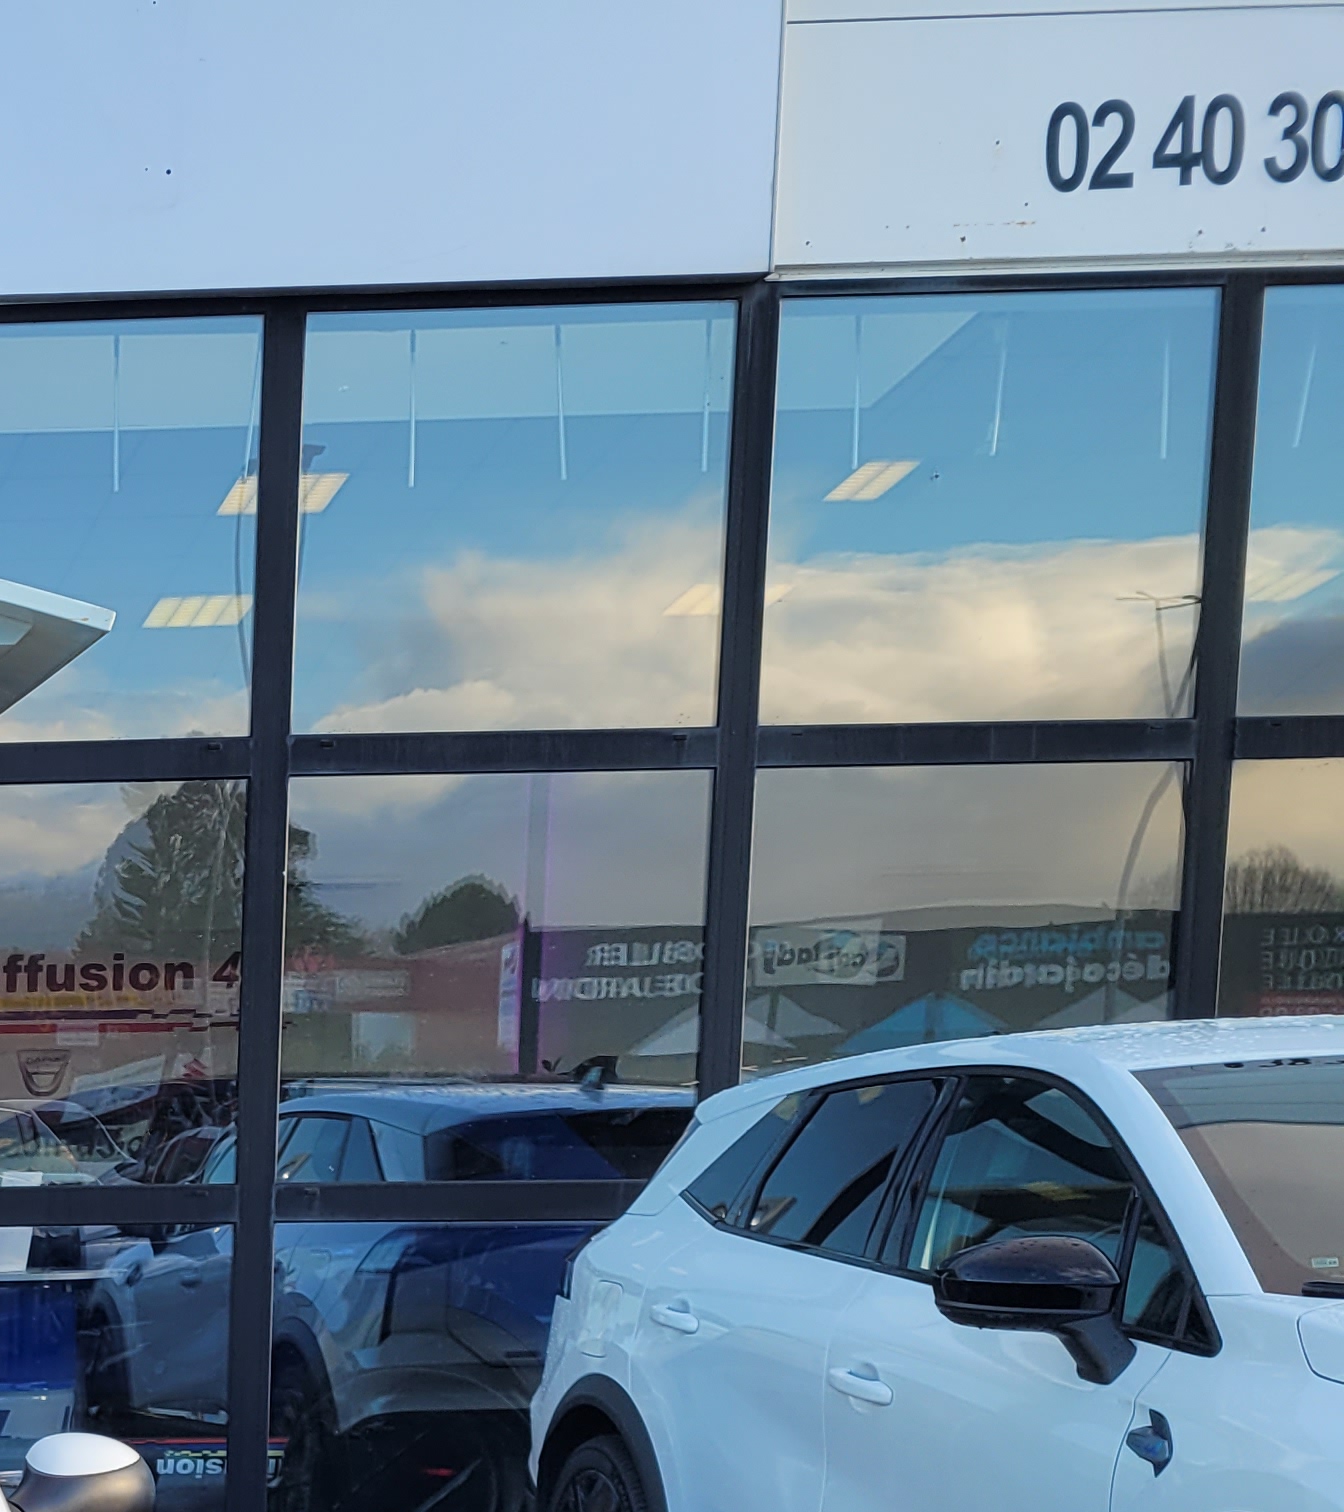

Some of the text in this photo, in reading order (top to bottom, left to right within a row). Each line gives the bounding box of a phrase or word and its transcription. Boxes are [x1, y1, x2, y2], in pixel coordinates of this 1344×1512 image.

[1046, 90, 1344, 193] 02 40 30
